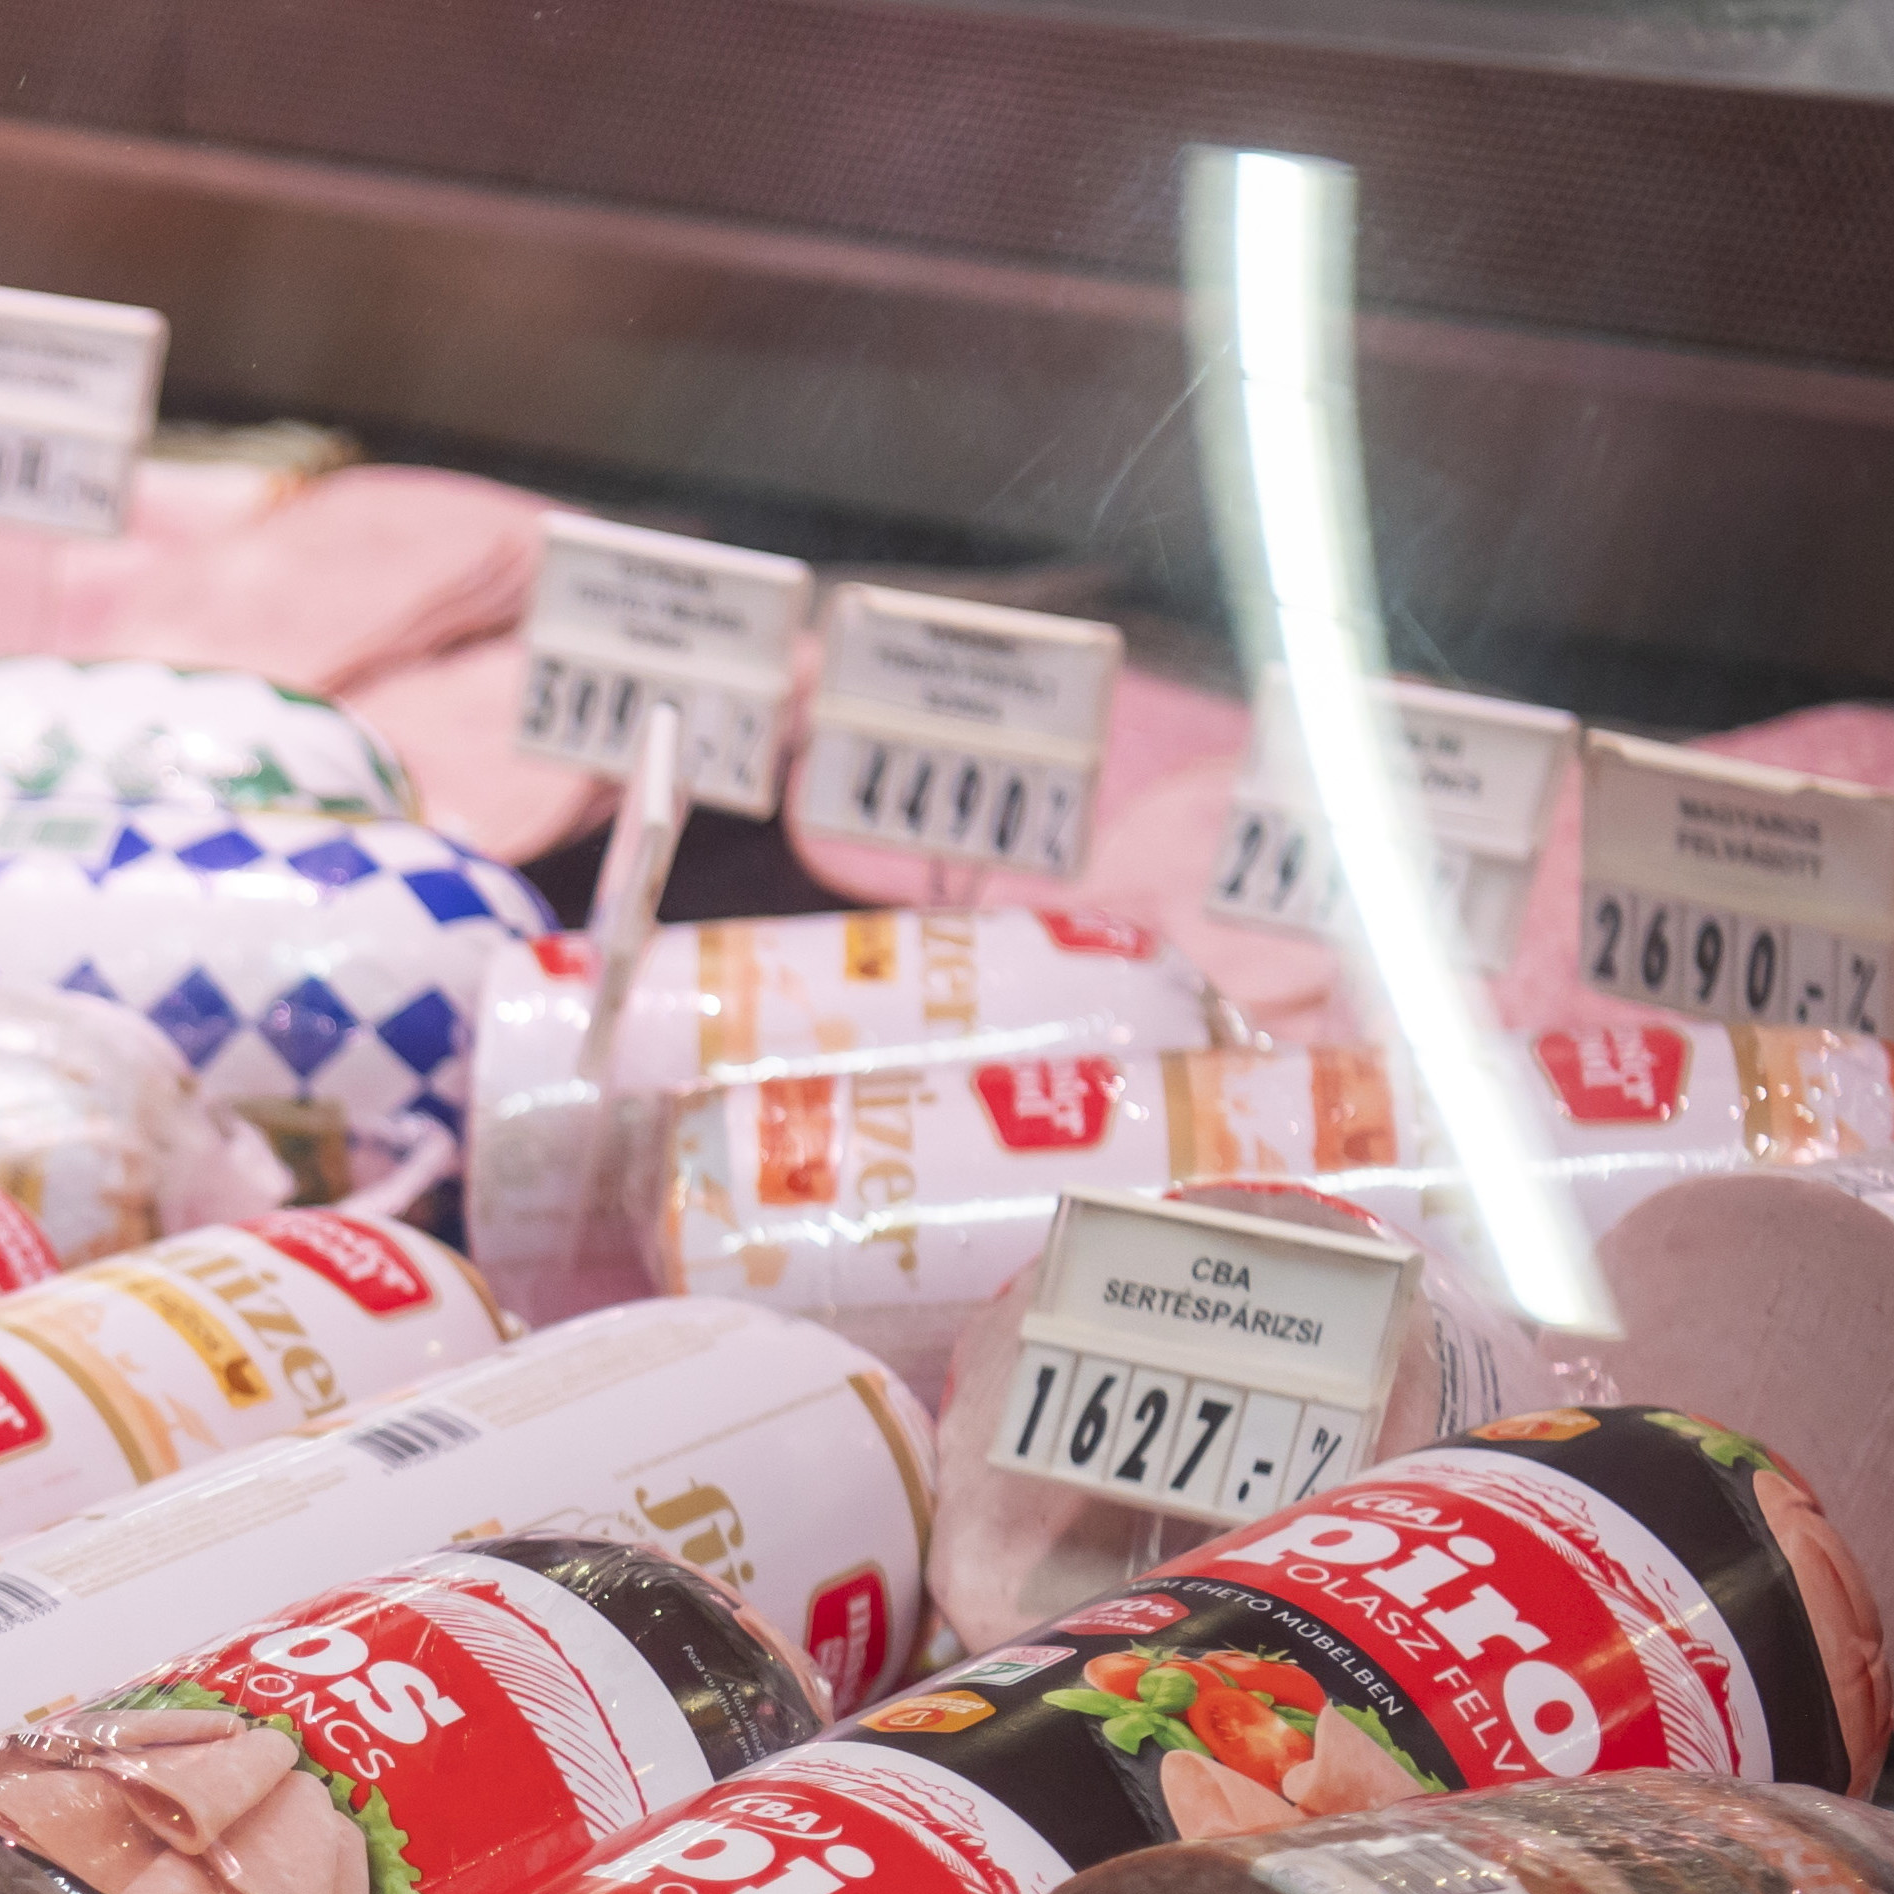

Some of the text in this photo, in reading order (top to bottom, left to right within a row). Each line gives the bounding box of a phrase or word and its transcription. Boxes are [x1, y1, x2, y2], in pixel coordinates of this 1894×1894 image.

[1103, 1279, 1324, 1348] SERTÉSPÁRIZSI
[1192, 1257, 1252, 1294] CBA
[1353, 1492, 1441, 1528] CBA
[1217, 1515, 1603, 1778] piro
[1284, 1562, 1442, 1662] OLASZ
[249, 1624, 466, 1745] os
[1273, 1603, 1404, 1718] MŰBÉLBEN
[730, 1796, 820, 1833] CBA
